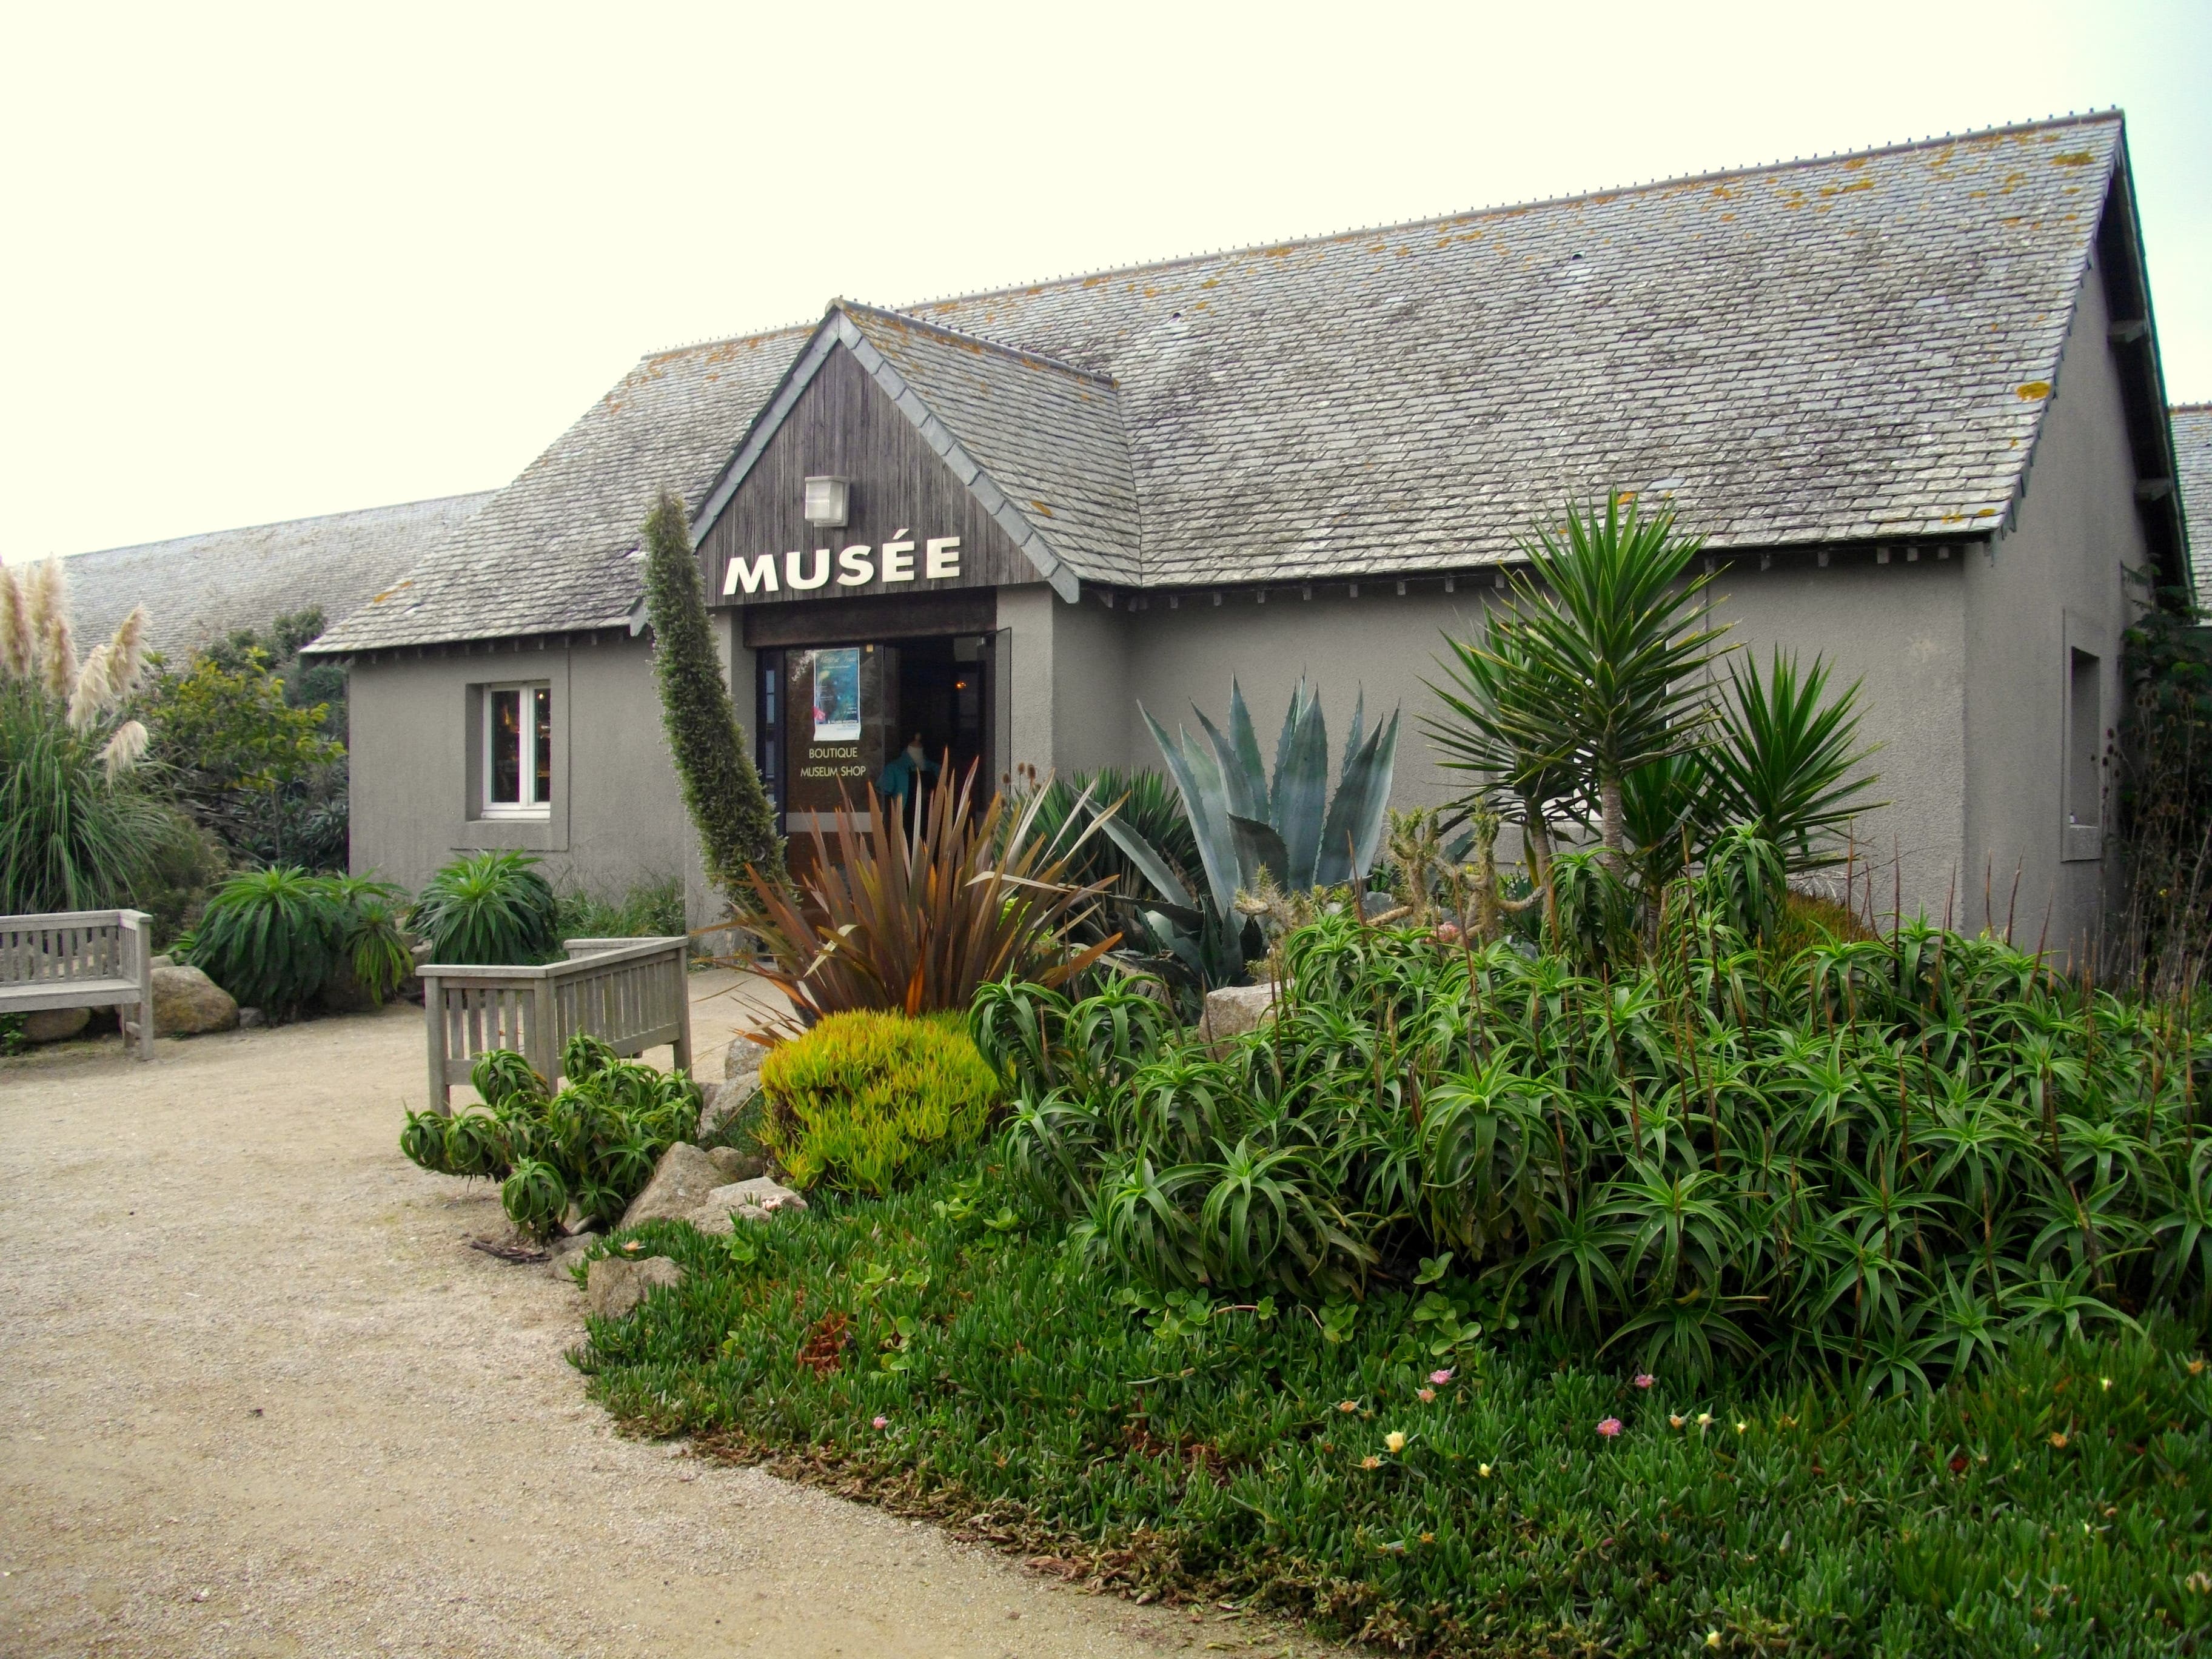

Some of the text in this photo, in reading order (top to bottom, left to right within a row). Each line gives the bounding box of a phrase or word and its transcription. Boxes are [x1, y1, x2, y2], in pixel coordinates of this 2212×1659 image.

[723, 529, 960, 595] MUSÉE
[809, 747, 858, 759] BOUTIQUE
[800, 765, 866, 777] MUSEUM SHOP
